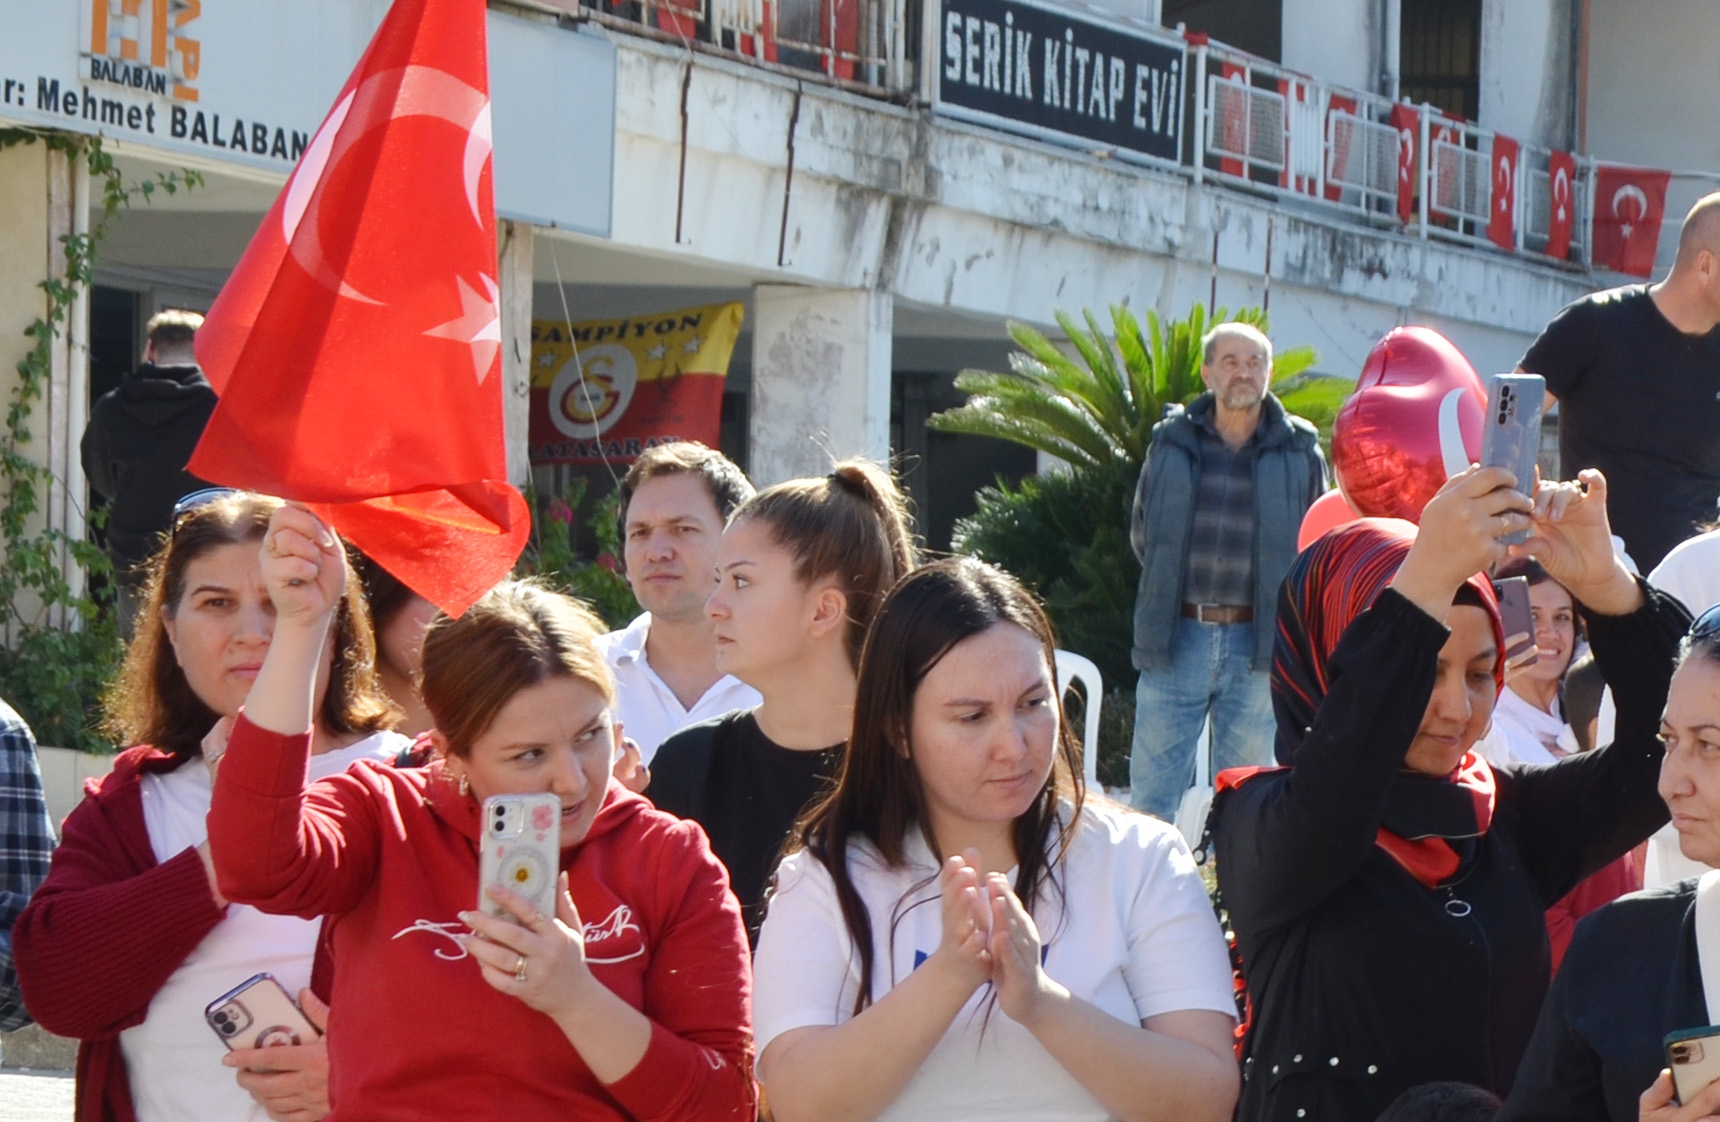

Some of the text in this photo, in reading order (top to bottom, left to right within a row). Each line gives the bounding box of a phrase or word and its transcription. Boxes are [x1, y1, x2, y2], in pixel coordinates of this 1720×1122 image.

[91, 58, 166, 95] BALABAN
[945, 10, 1179, 138] SERİK KİTAP EVİ
[36, 75, 156, 134] Mehmet
[171, 105, 309, 162] BALABAN
